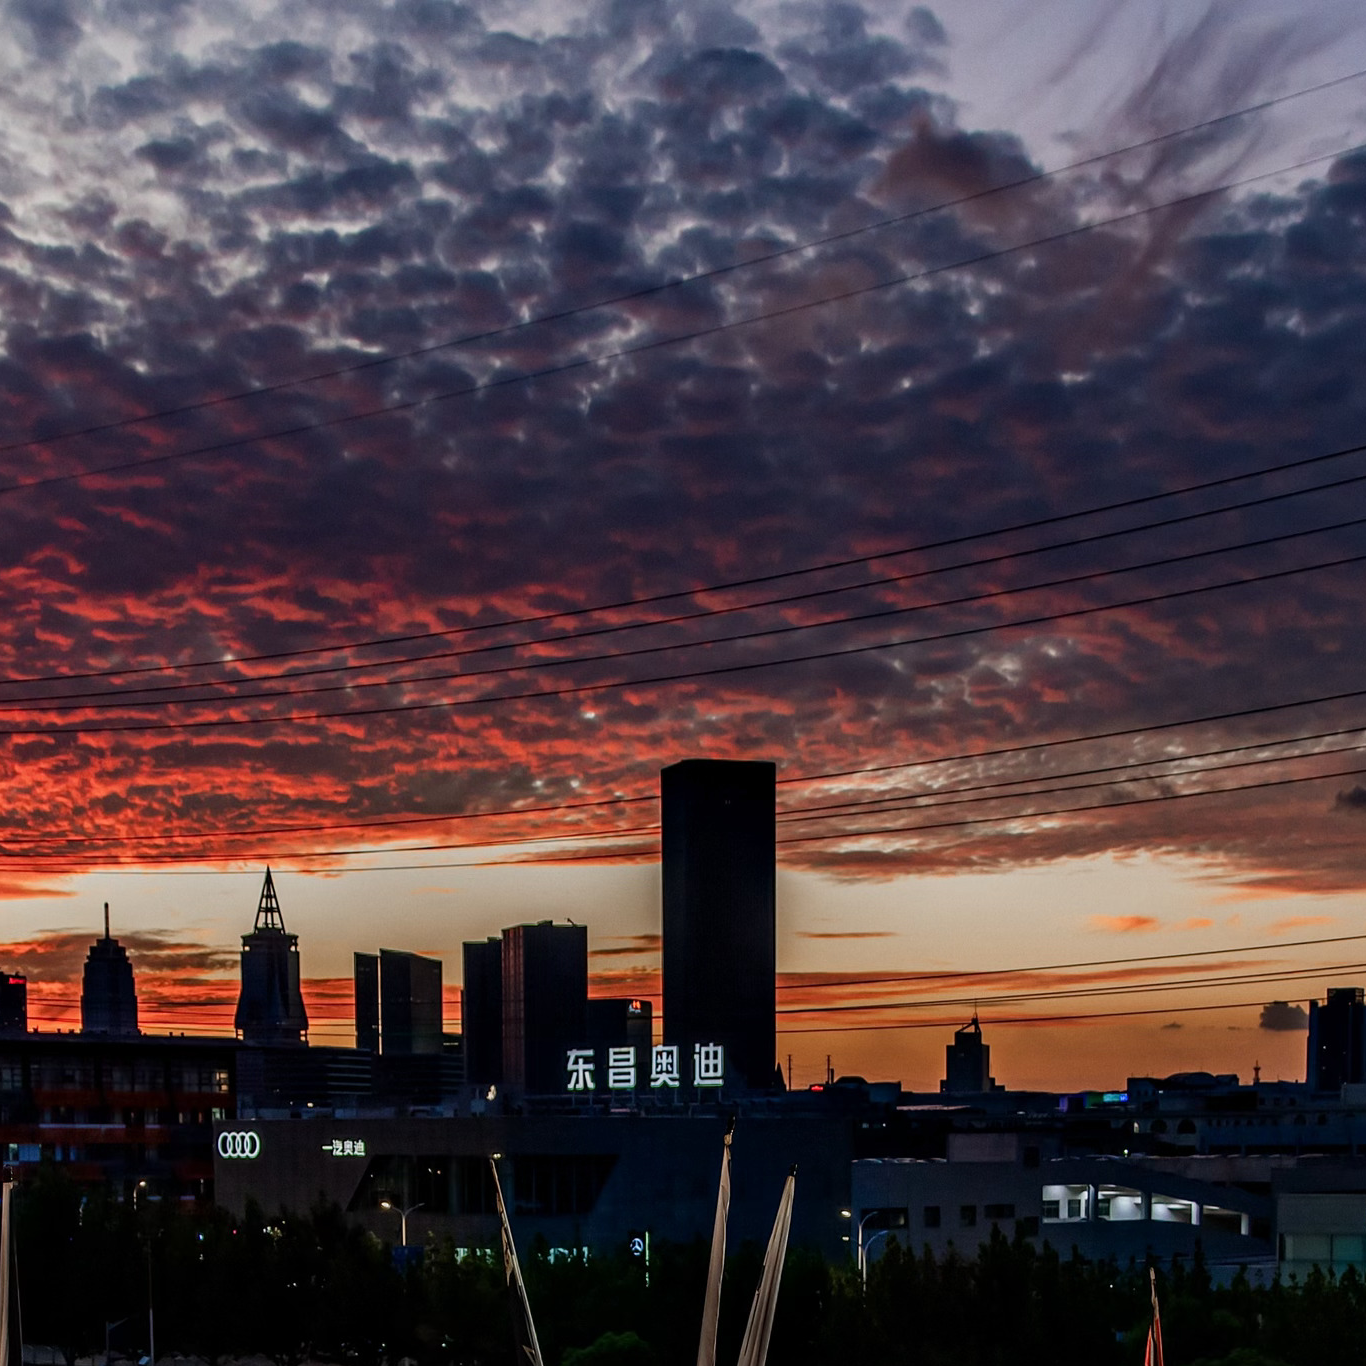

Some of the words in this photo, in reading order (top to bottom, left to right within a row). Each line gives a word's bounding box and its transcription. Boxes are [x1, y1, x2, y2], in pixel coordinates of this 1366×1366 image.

[566, 1042, 724, 1090] 东昌奥迪
[322, 1139, 365, 1156] 一汽奥迪
